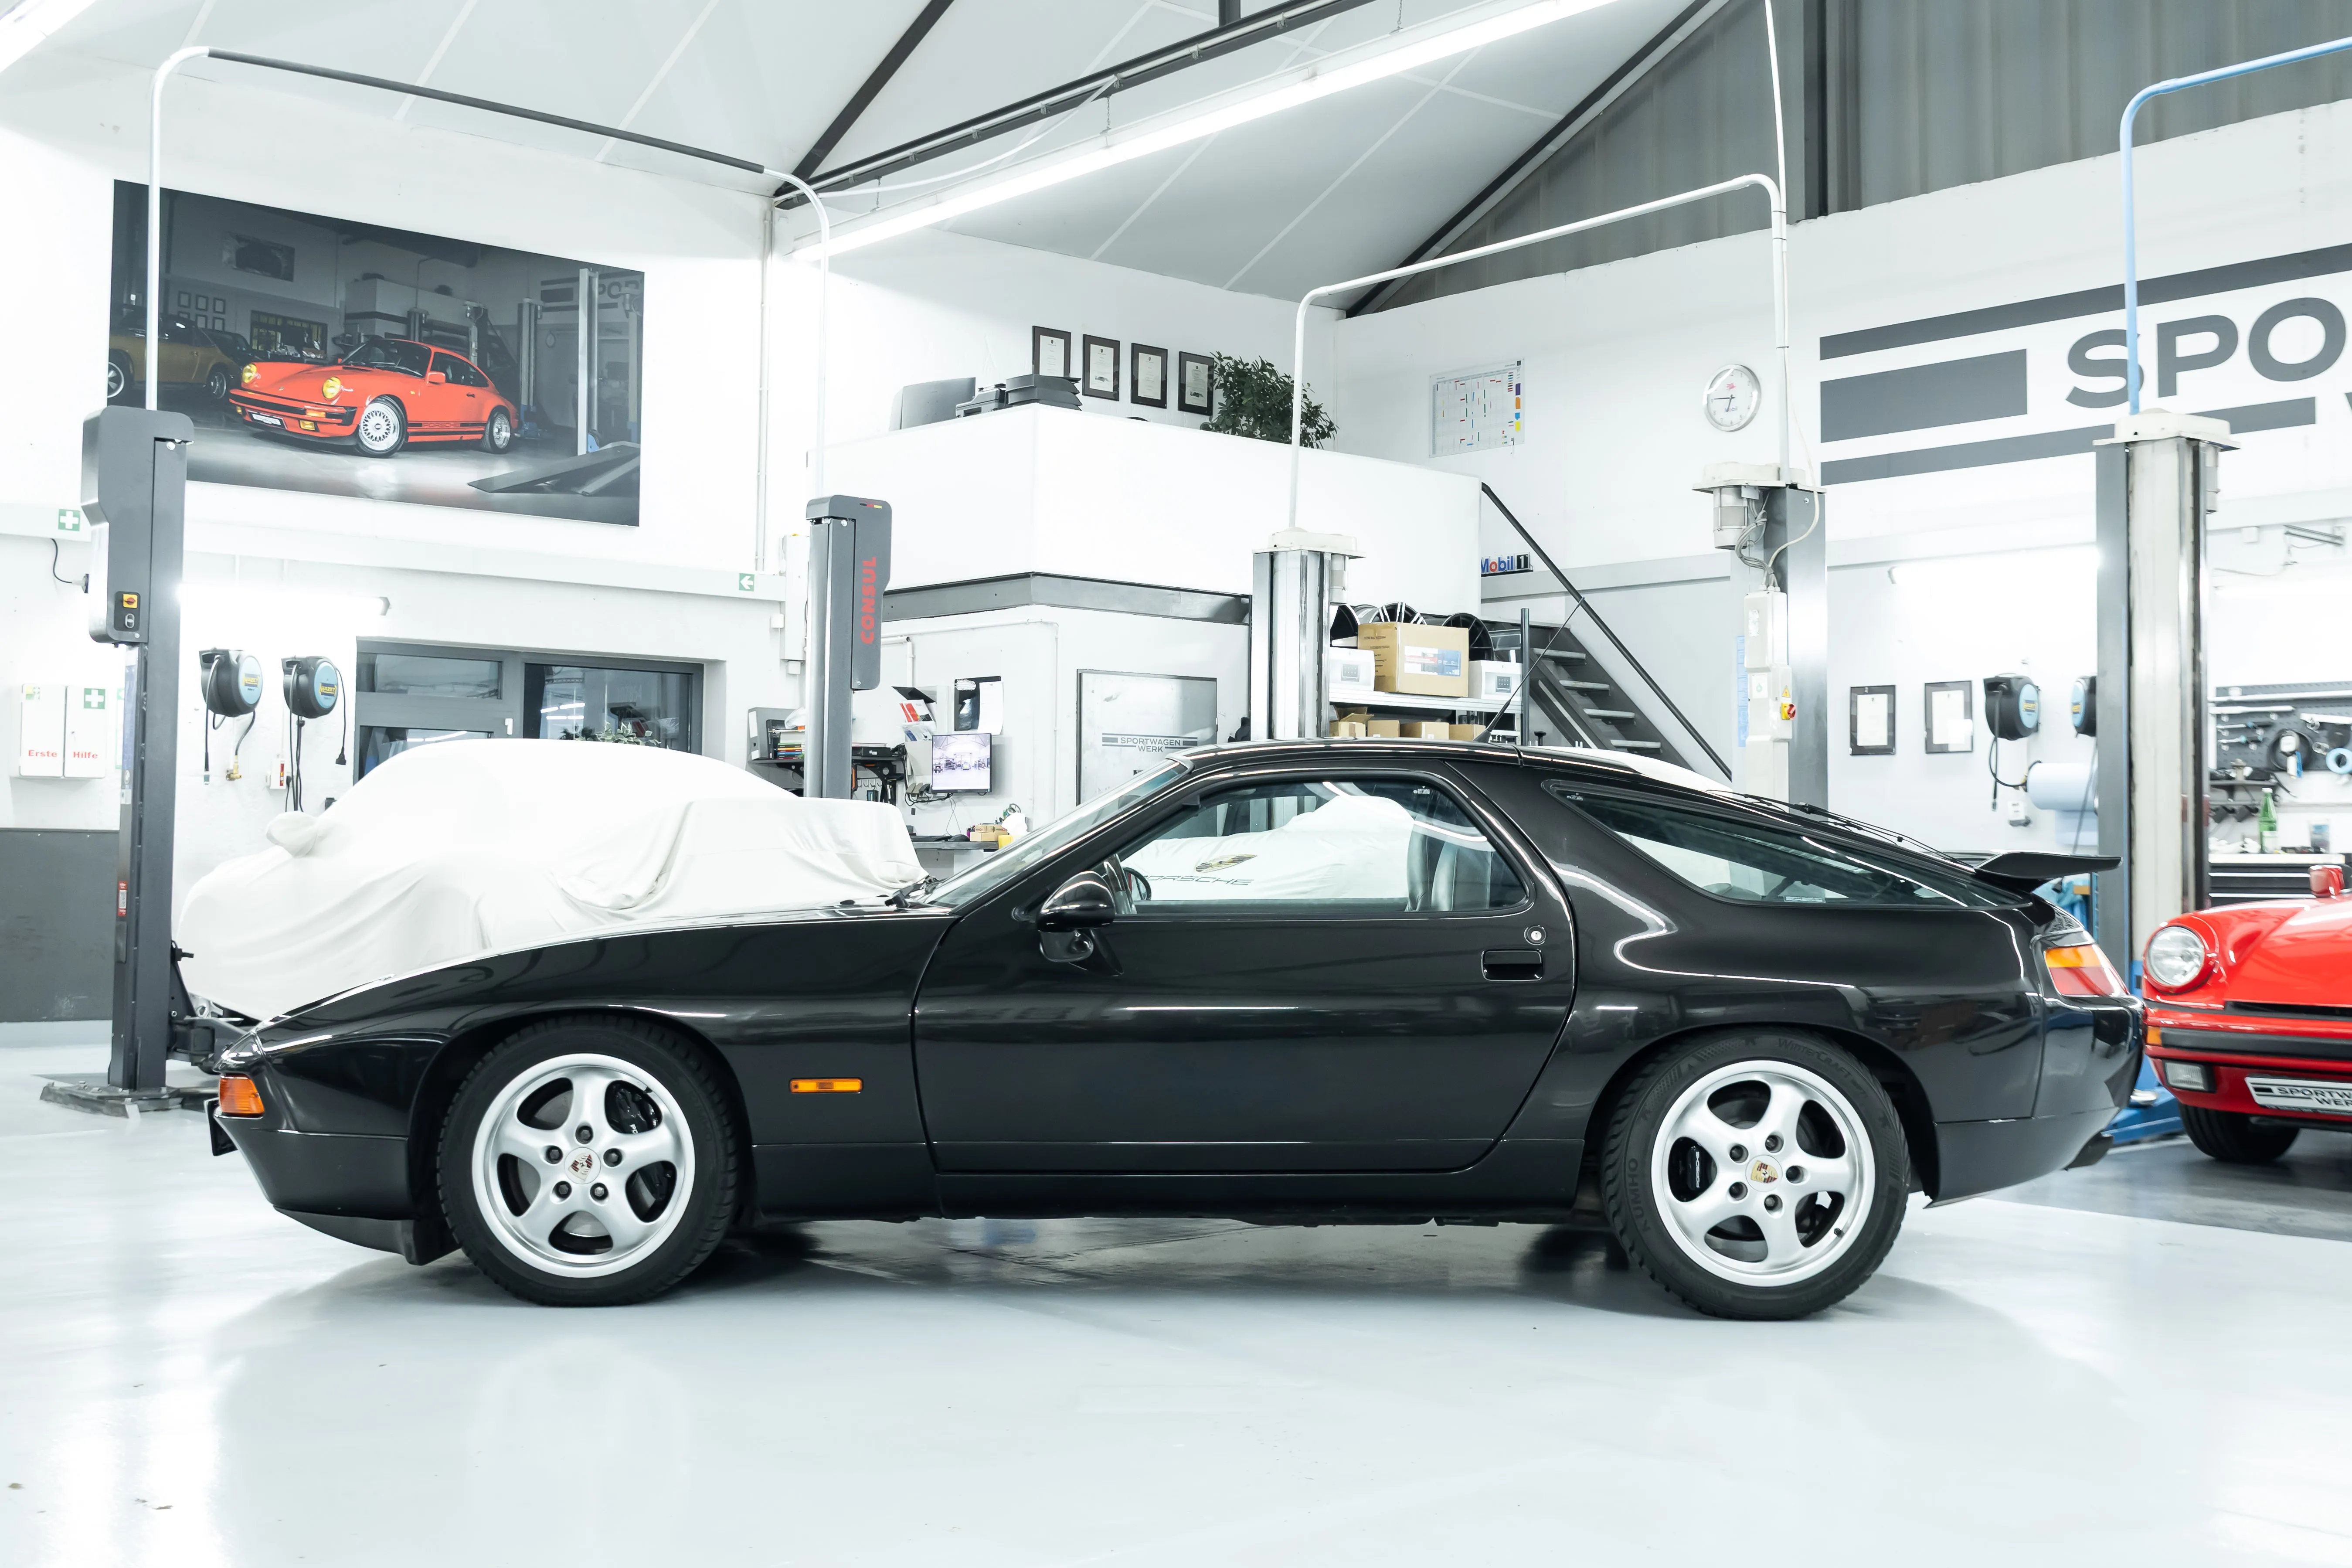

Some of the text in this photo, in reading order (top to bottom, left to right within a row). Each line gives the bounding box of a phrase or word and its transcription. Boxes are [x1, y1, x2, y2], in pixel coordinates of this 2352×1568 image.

[1481, 556, 1513, 573] Mobil
[860, 557, 877, 644] CONSUL
[1120, 737, 1180, 746] SPORTWAGEN
[28, 749, 57, 758] Erste
[1144, 875, 1254, 885] ORSCHE
[2277, 1087, 2352, 1099] SPORTW
[2315, 1097, 2352, 1106] WER
[1628, 1158, 1652, 1232] KUMHO
